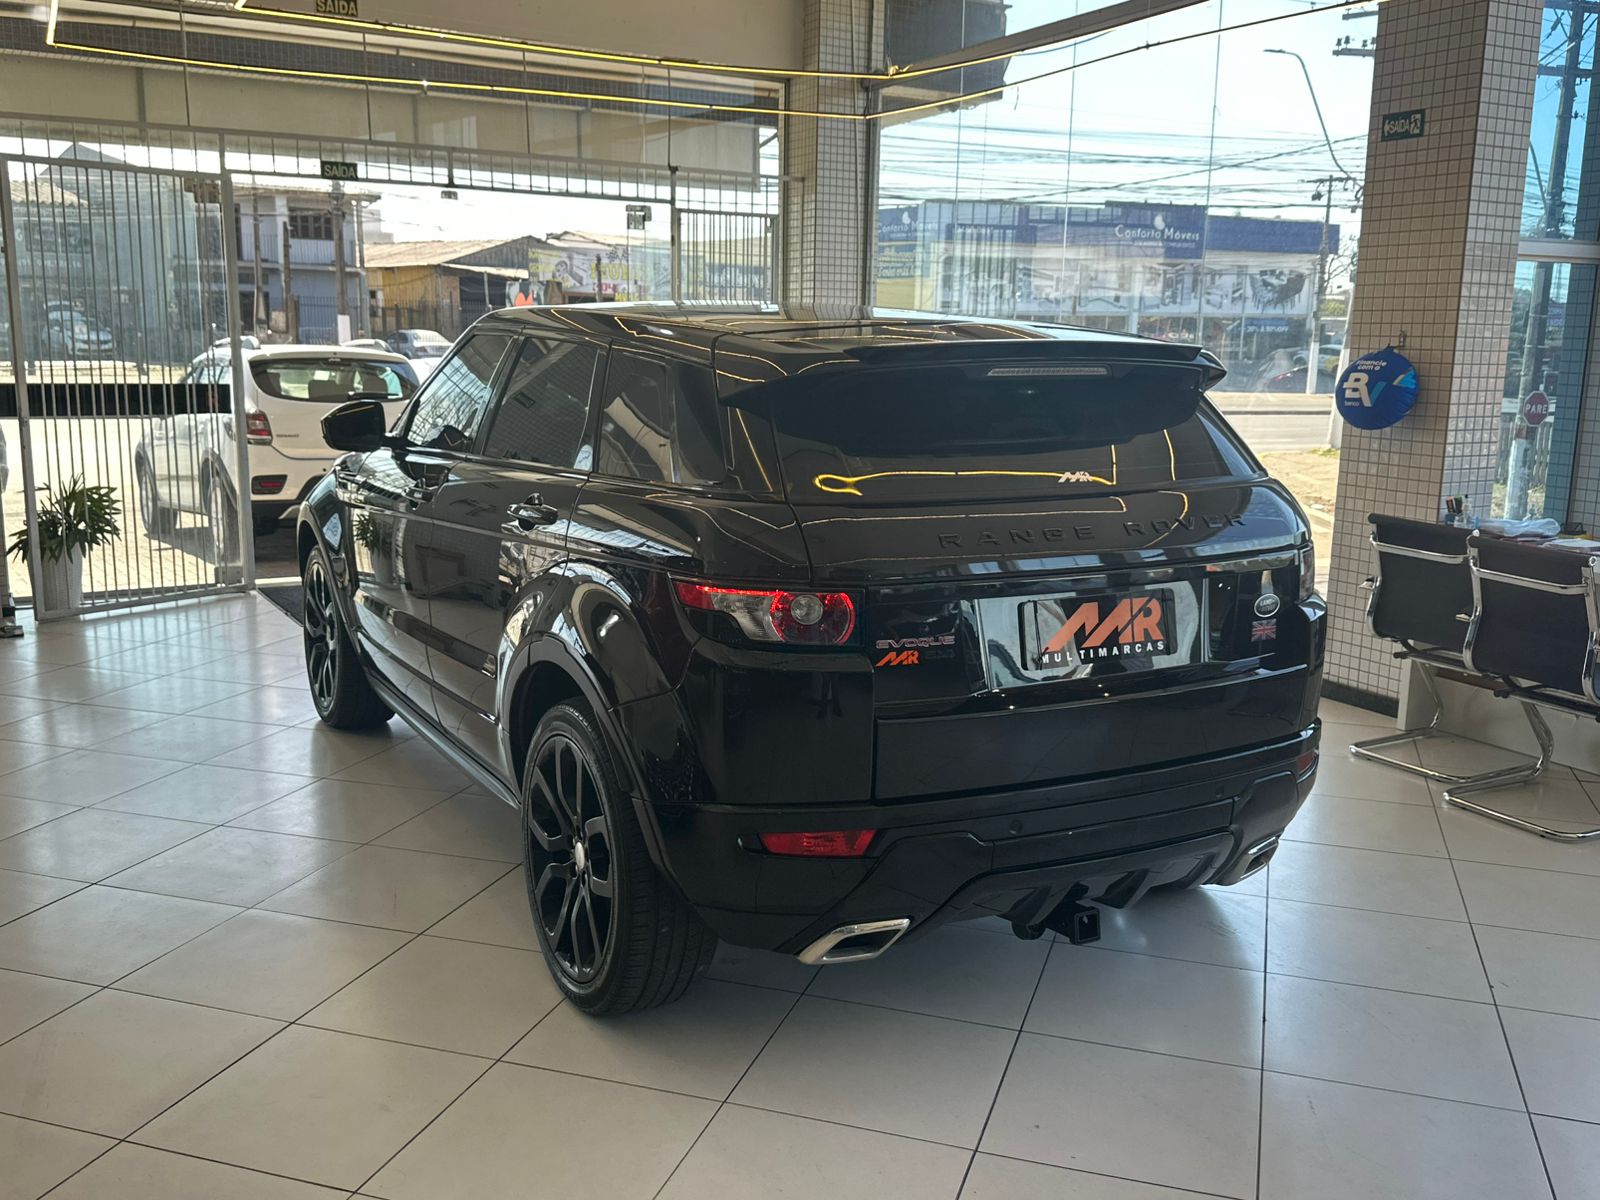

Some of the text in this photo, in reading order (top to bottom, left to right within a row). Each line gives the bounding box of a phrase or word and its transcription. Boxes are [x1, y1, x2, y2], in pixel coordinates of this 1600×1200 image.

[1115, 224, 1161, 239] Conforto
[1525, 404, 1547, 414] PARE
[938, 513, 1247, 549] RANGE ROVER
[875, 635, 956, 649] EVOQUE
[1041, 640, 1166, 664] MULTIMARCAS
